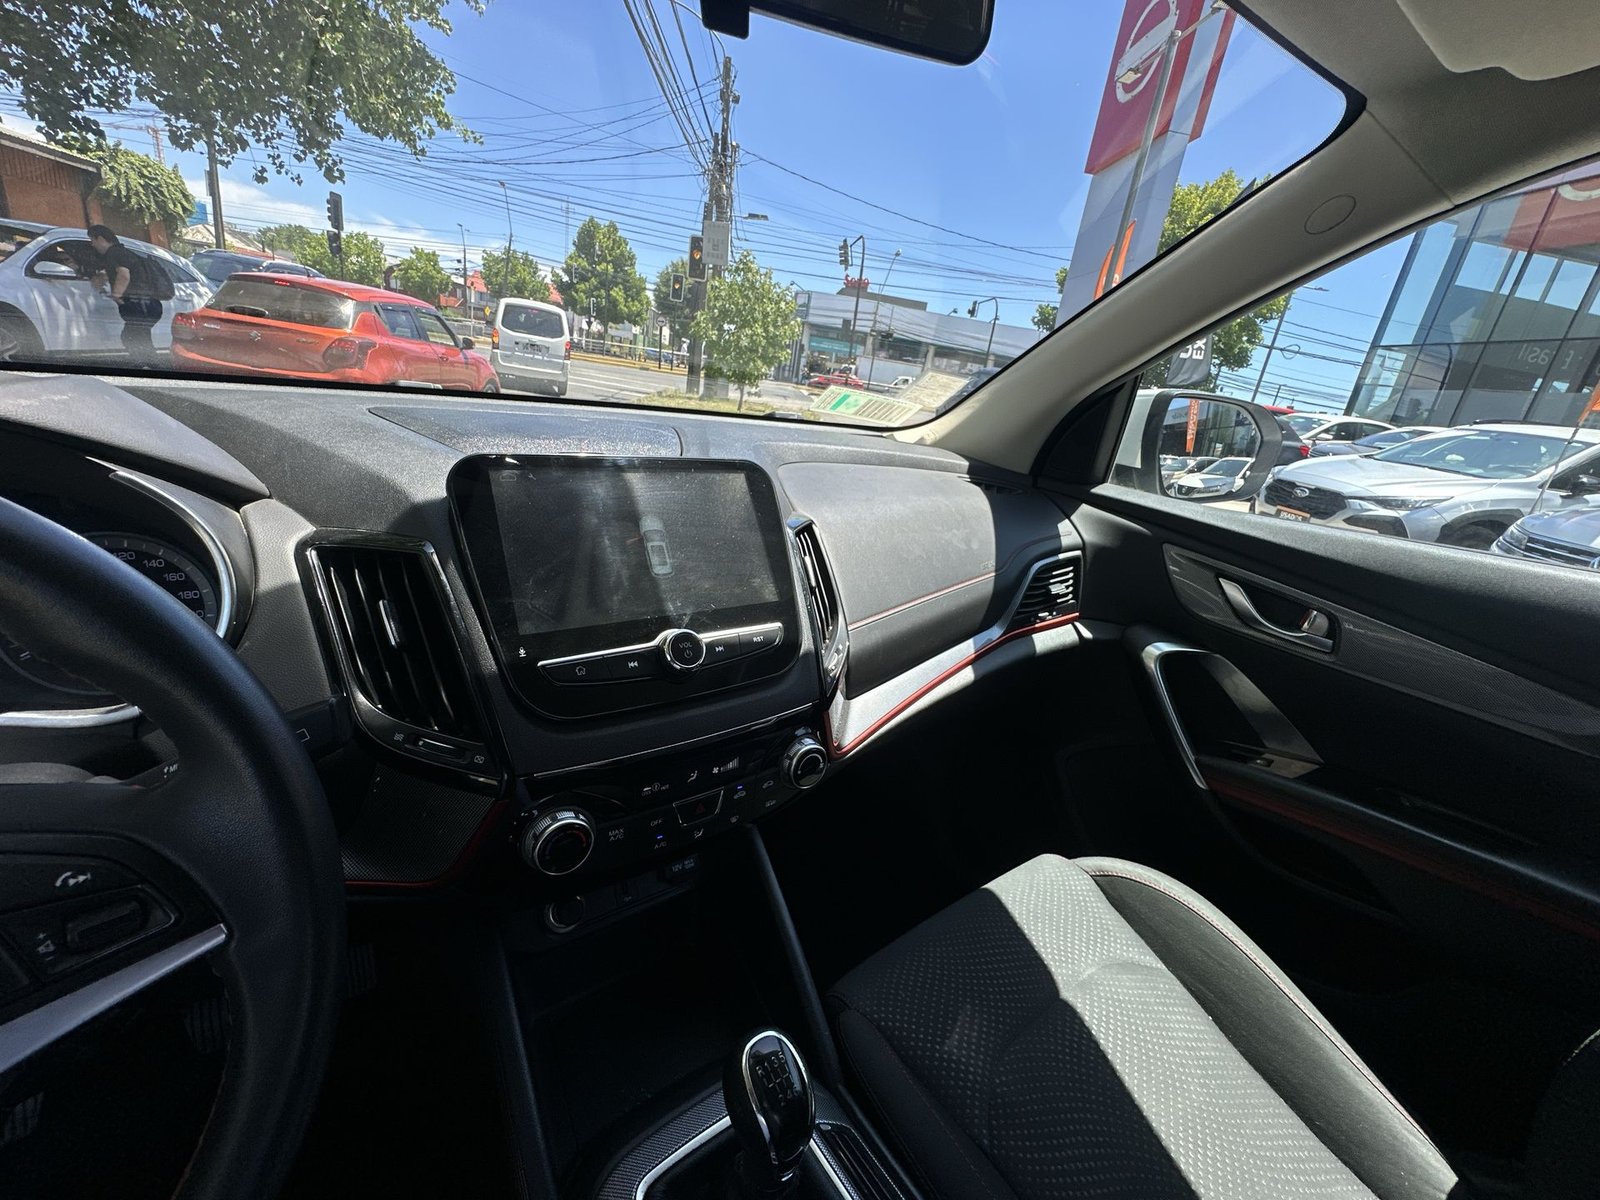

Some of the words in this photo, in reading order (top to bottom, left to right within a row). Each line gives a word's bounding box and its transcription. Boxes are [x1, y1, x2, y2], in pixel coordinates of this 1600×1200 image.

[142, 559, 165, 568] 140
[163, 572, 185, 581] 160
[177, 590, 200, 599] 180
[679, 641, 693, 649] VOL
[650, 818, 663, 827] OFF
[608, 828, 624, 836] MAX
[609, 833, 624, 842] A/C
[654, 841, 667, 849] A/C
[771, 1056, 779, 1067] 3
[778, 1051, 786, 1063] 5
